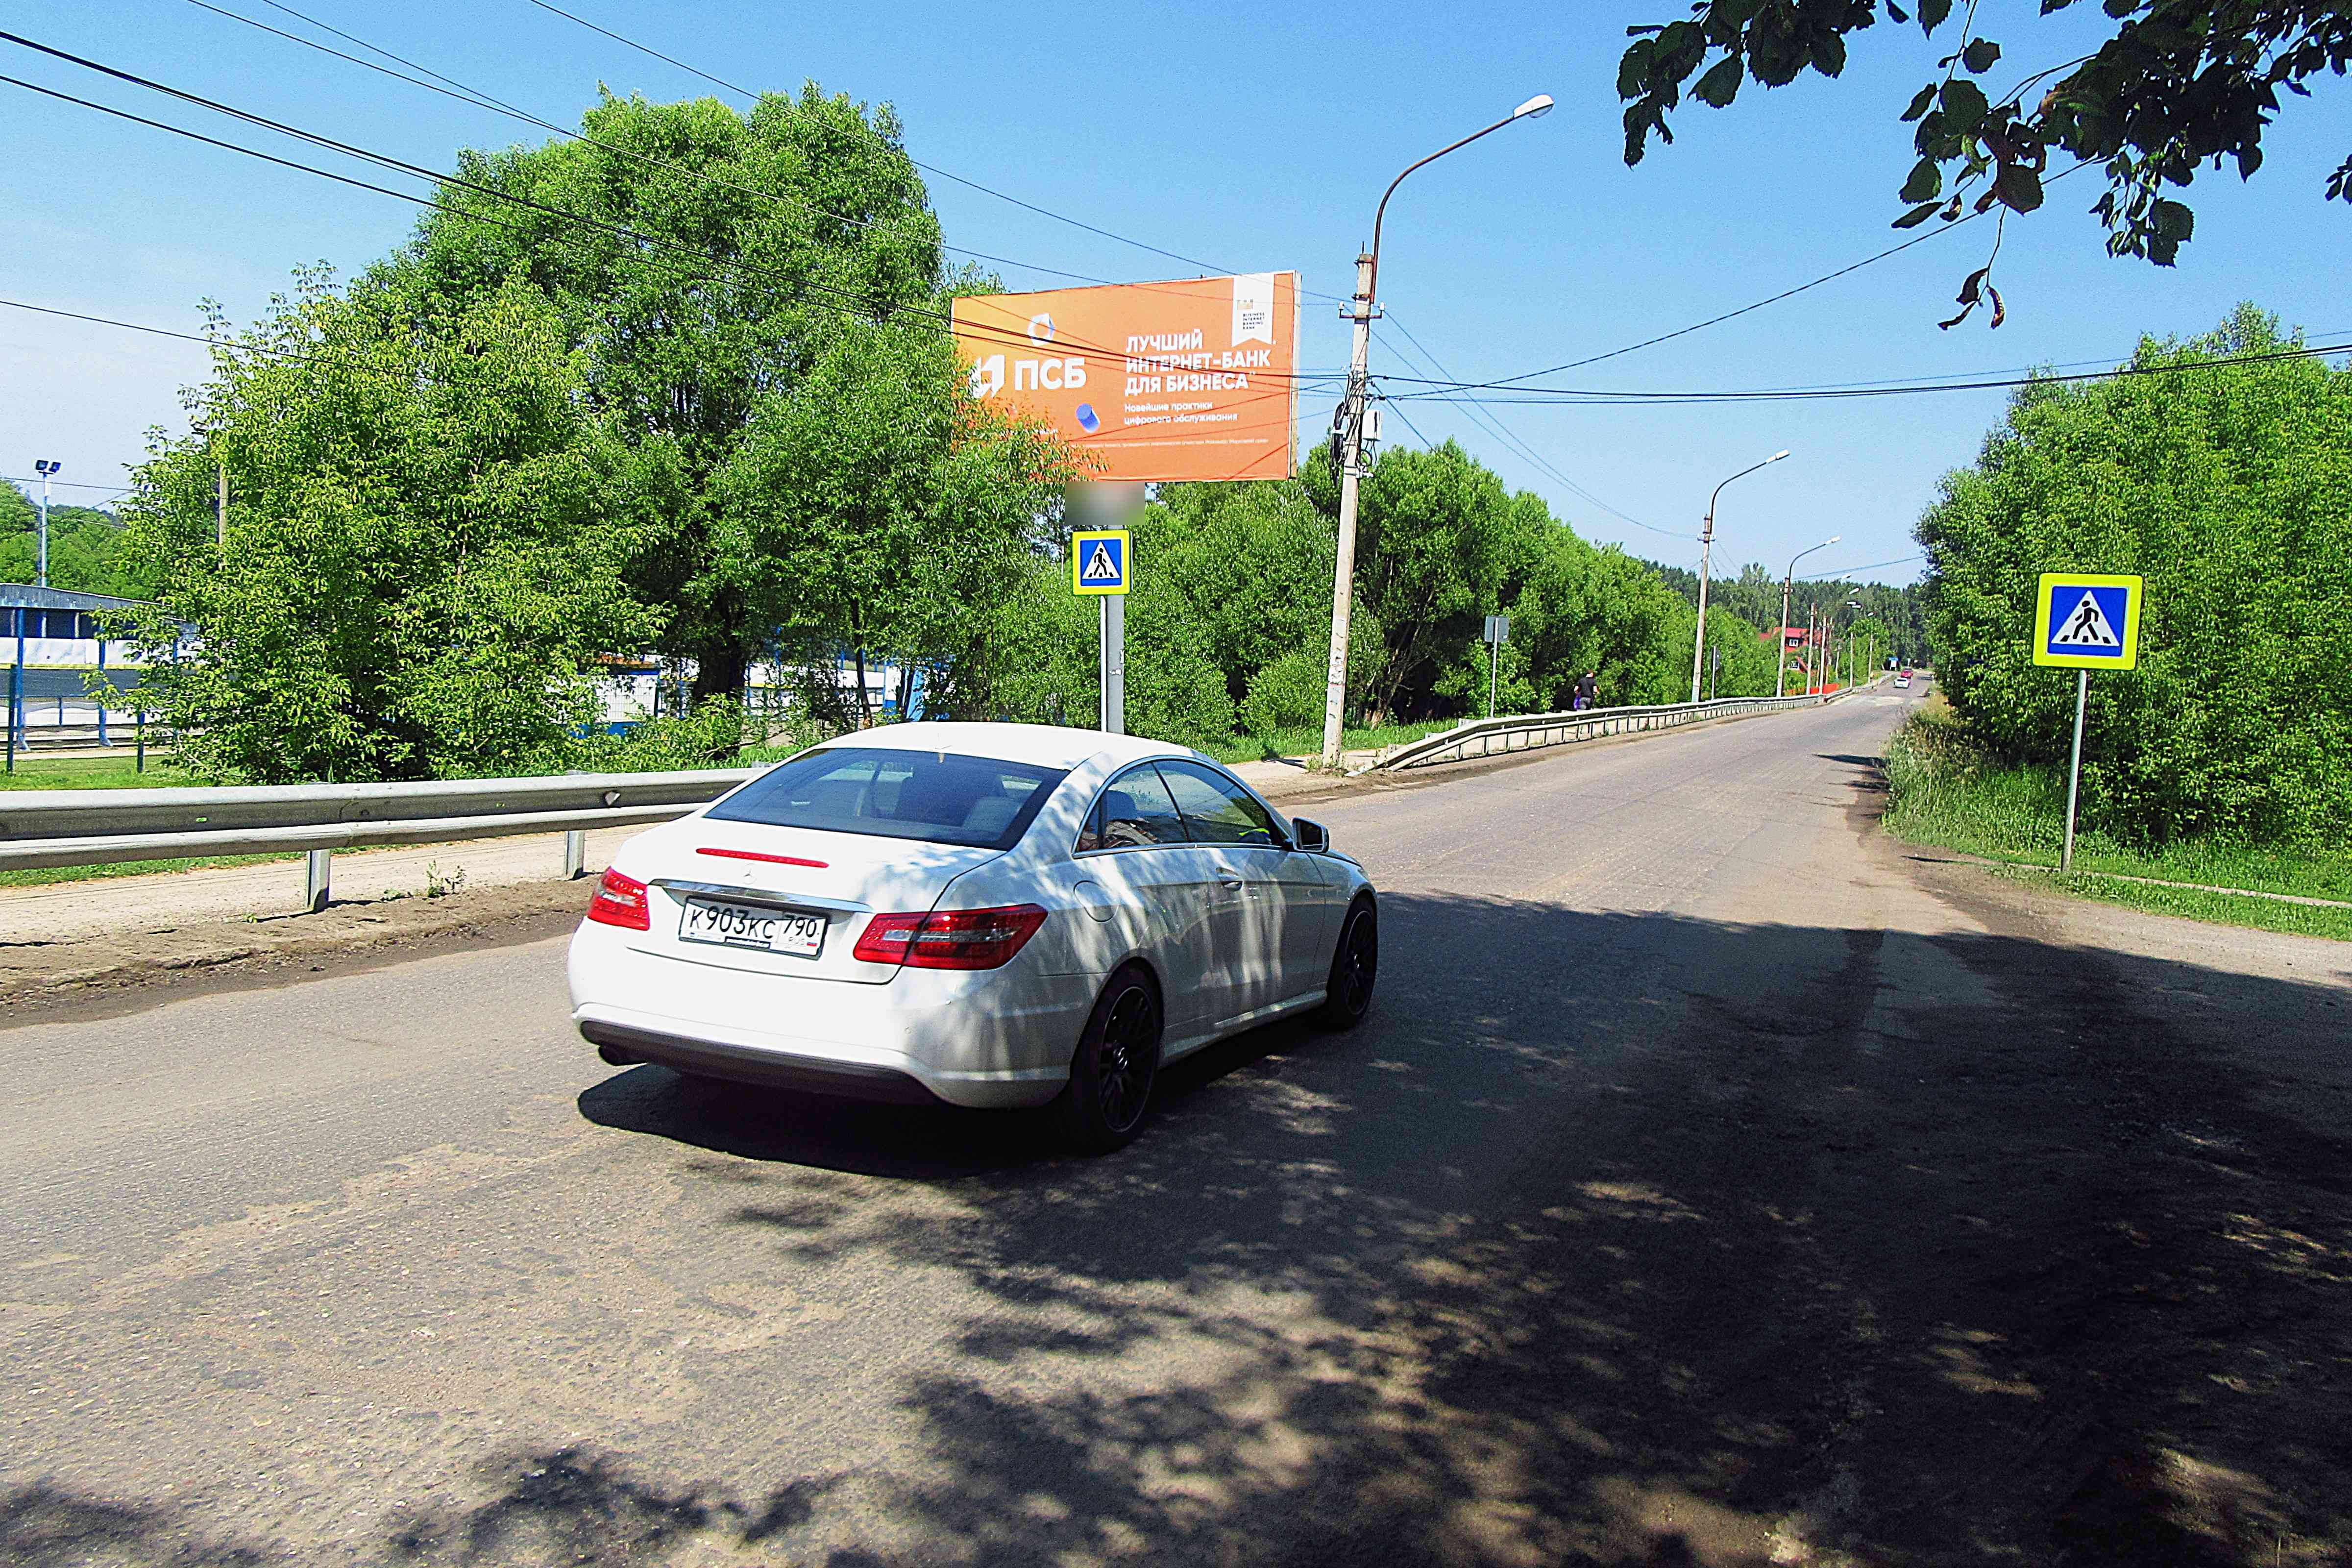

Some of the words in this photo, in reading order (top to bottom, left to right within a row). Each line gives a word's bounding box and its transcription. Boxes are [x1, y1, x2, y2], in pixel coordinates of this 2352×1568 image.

[1126, 329, 1203, 352] ЛУЧШИЙ
[1126, 349, 1271, 373] ИНТЕРНЕТ-БАНК
[1015, 358, 1087, 391] ПСБ
[1125, 376, 1161, 396] ДЛЯ
[1125, 402, 1169, 412] Новейшие
[1172, 402, 1213, 412] практики
[1124, 416, 1171, 426] цифрового
[1174, 413, 1239, 423] обслуживания
[784, 912, 817, 938] 790
